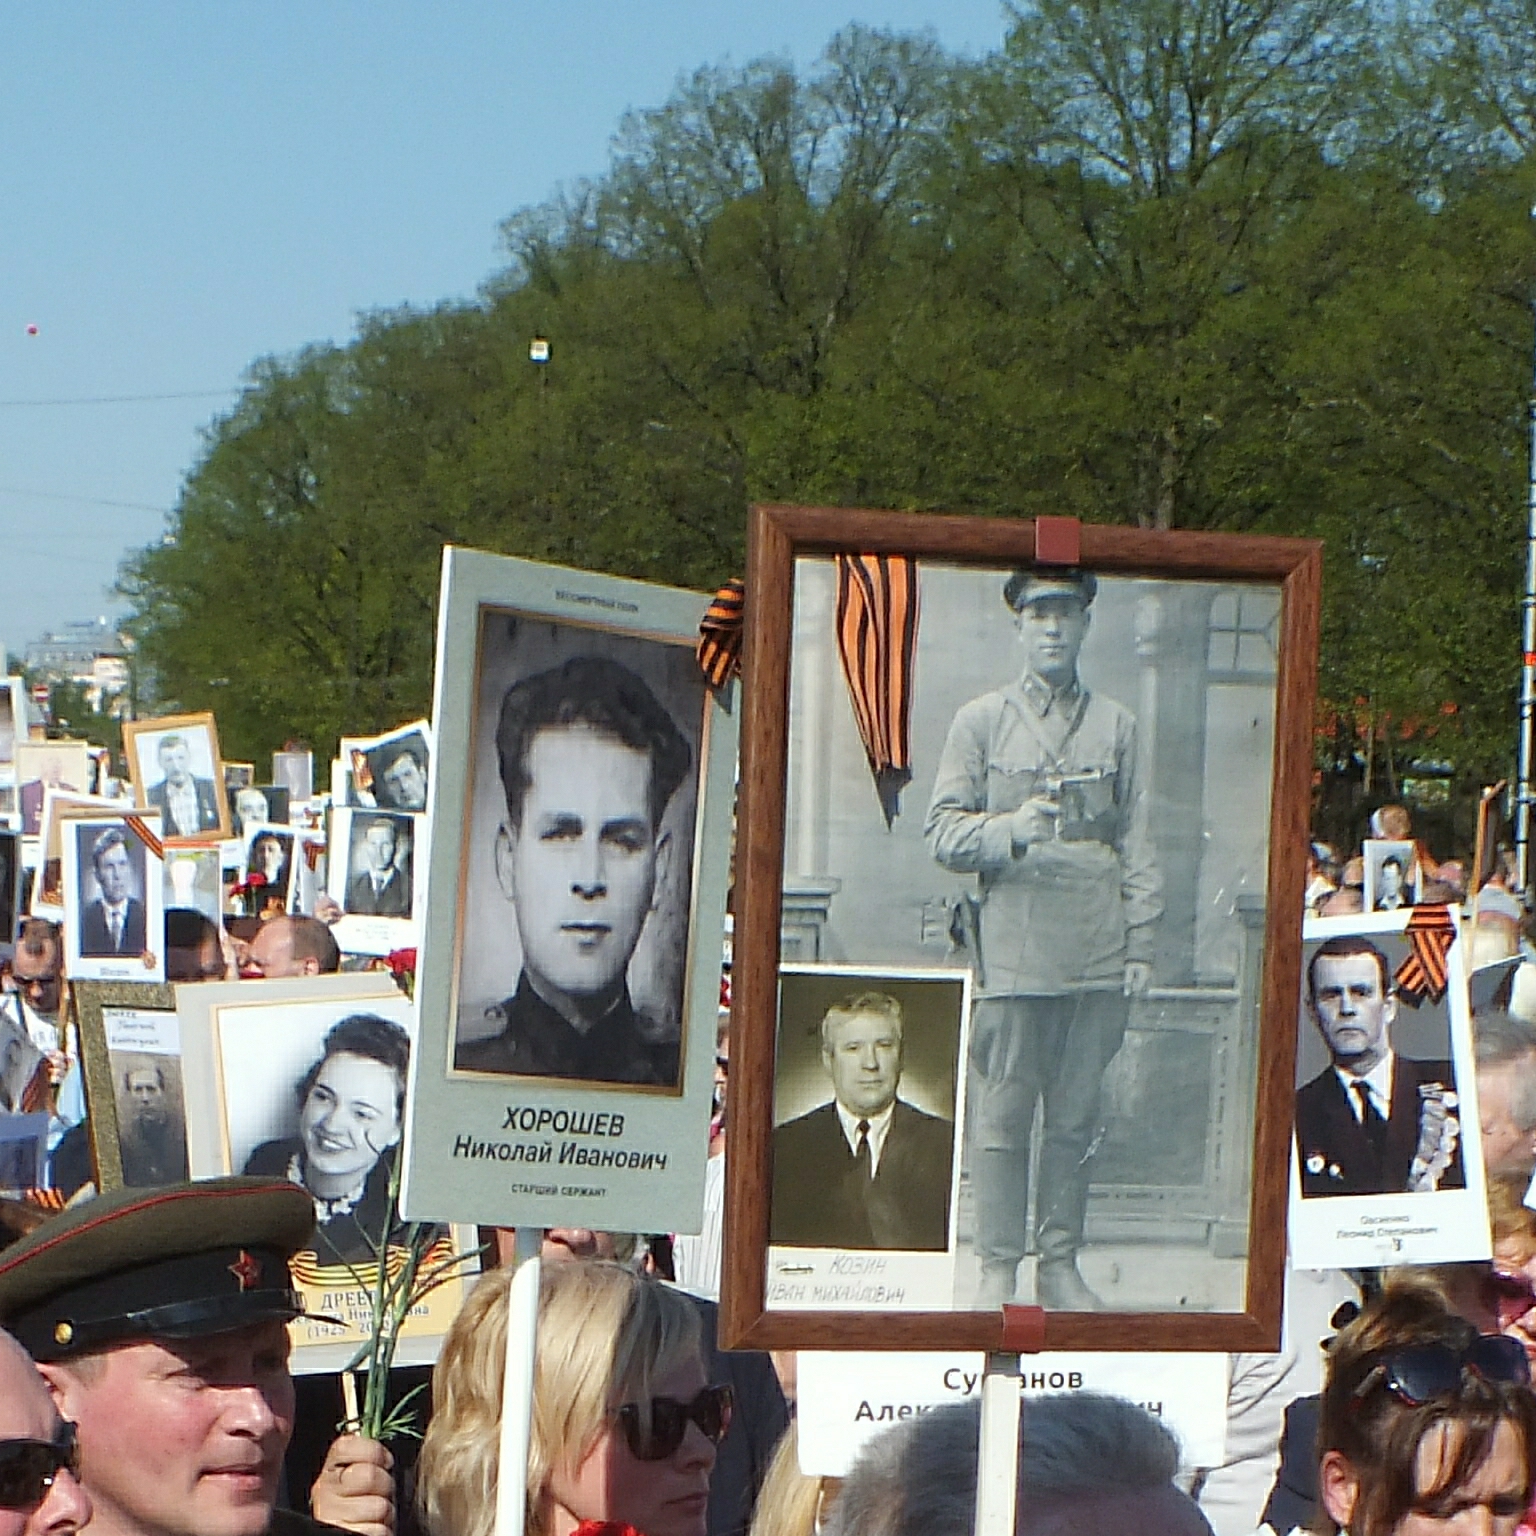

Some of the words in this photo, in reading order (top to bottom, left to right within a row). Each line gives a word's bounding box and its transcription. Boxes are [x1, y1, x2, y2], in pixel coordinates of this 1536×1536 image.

[502, 1106, 625, 1137] ХОРОШЕВ
[453, 1134, 553, 1164] Николай
[558, 1141, 668, 1171] Иванович
[511, 1183, 559, 1196] СТАРШИЙ
[561, 1185, 607, 1198] СЕРЖАНТ
[943, 1368, 1084, 1395] Суанов
